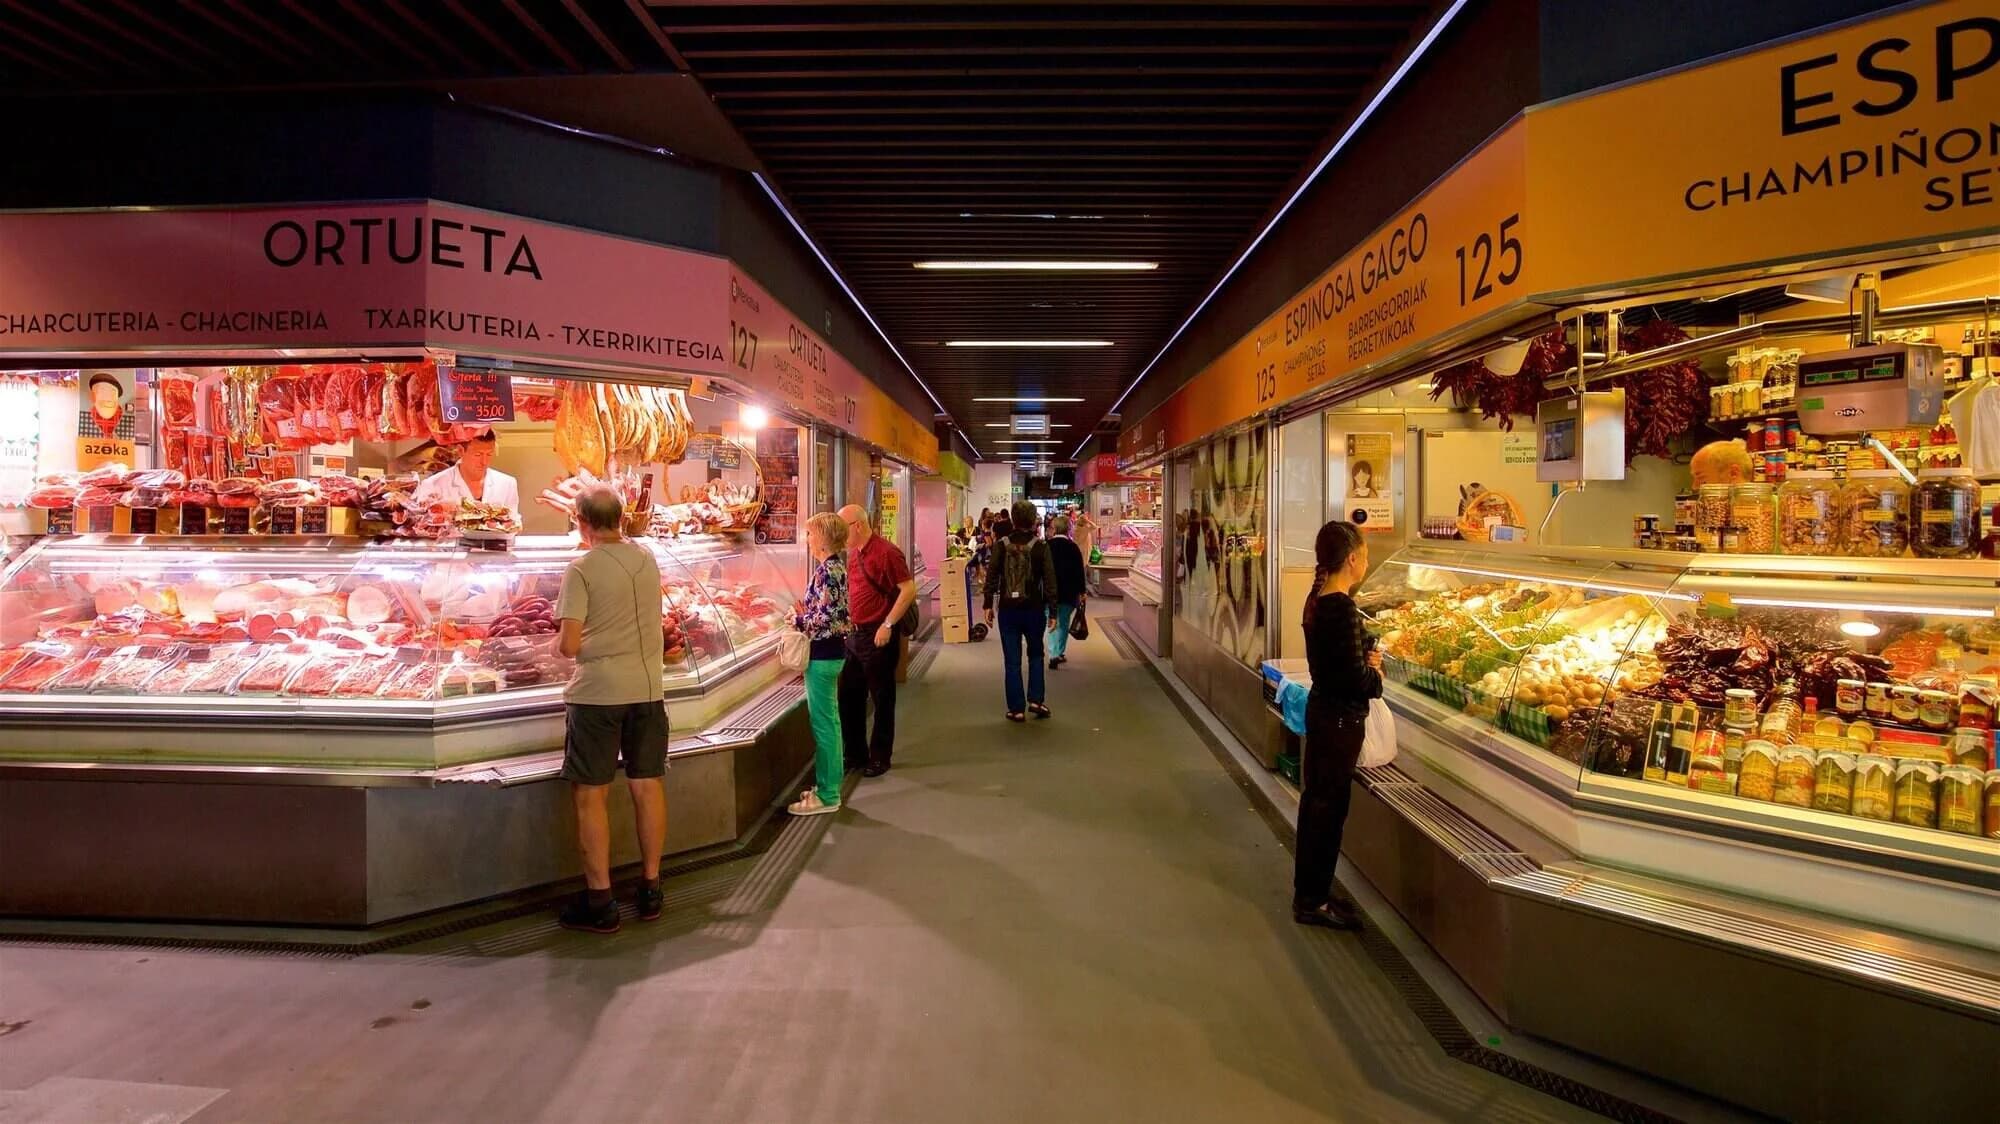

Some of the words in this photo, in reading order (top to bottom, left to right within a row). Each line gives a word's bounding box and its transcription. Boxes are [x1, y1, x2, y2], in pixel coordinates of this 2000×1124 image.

[1780, 17, 2000, 137] ESP
[1923, 167, 2000, 212] SE
[264, 217, 543, 281] ORTUETA
[1455, 213, 1522, 307] 125
[1285, 268, 1356, 347] ESPINOSA
[1360, 212, 1429, 294] GAGO
[180, 310, 328, 333] CHACINERIA
[365, 308, 541, 342] TXARKUTERIA
[561, 325, 725, 362] TXERRIKITEGIA
[1348, 279, 1428, 341] BARRENGORRIAK
[1348, 311, 1417, 363] PERRETXIKOAK
[731, 319, 758, 373] 127
[788, 323, 827, 377] ORTUETA
[1307, 360, 1327, 383] SETAS
[1256, 363, 1276, 405] 125
[85, 442, 129, 457] azoka
